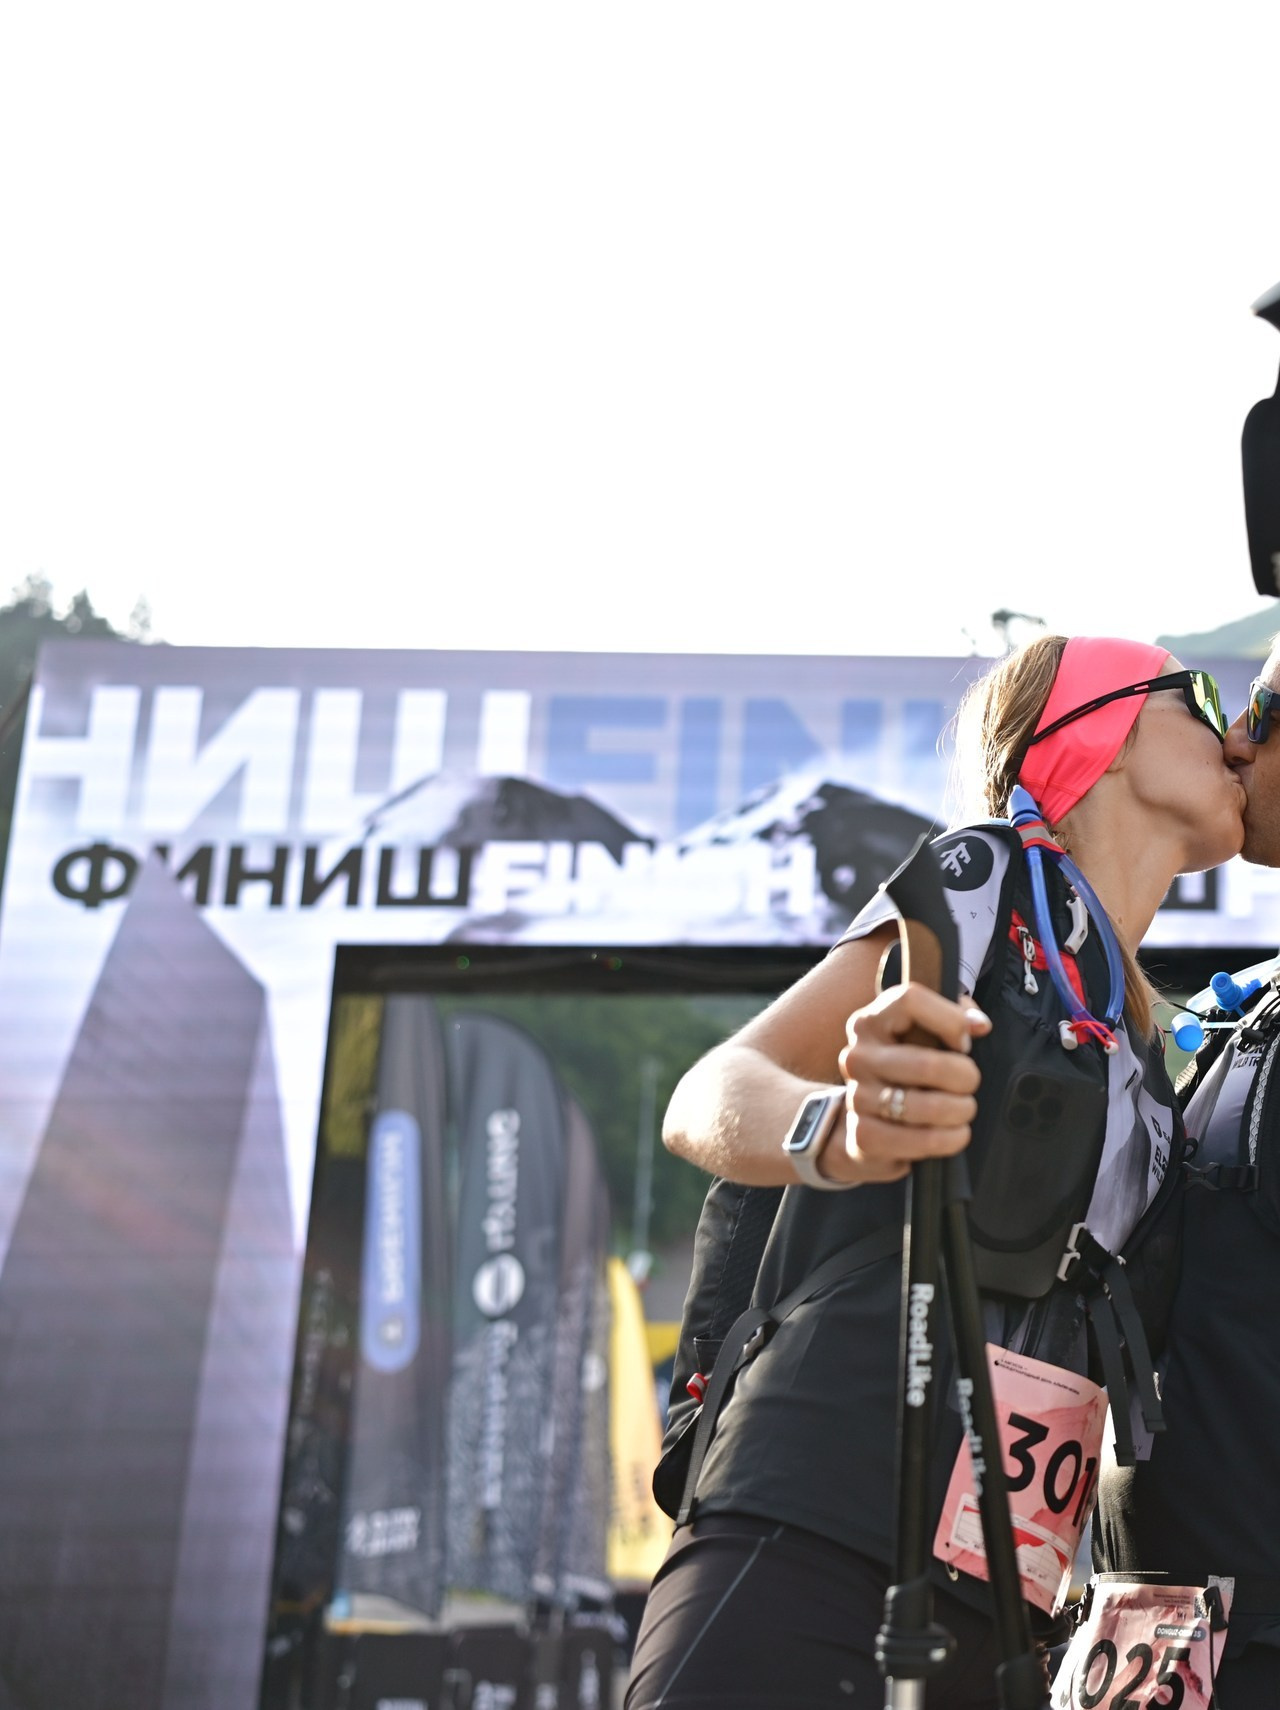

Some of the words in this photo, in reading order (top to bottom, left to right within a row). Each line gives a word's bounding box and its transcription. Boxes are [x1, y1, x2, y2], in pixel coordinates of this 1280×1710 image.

[907, 1283, 935, 1408] RoadLike
[1003, 1411, 1097, 1528] 301
[1078, 1639, 1191, 1710] 025
